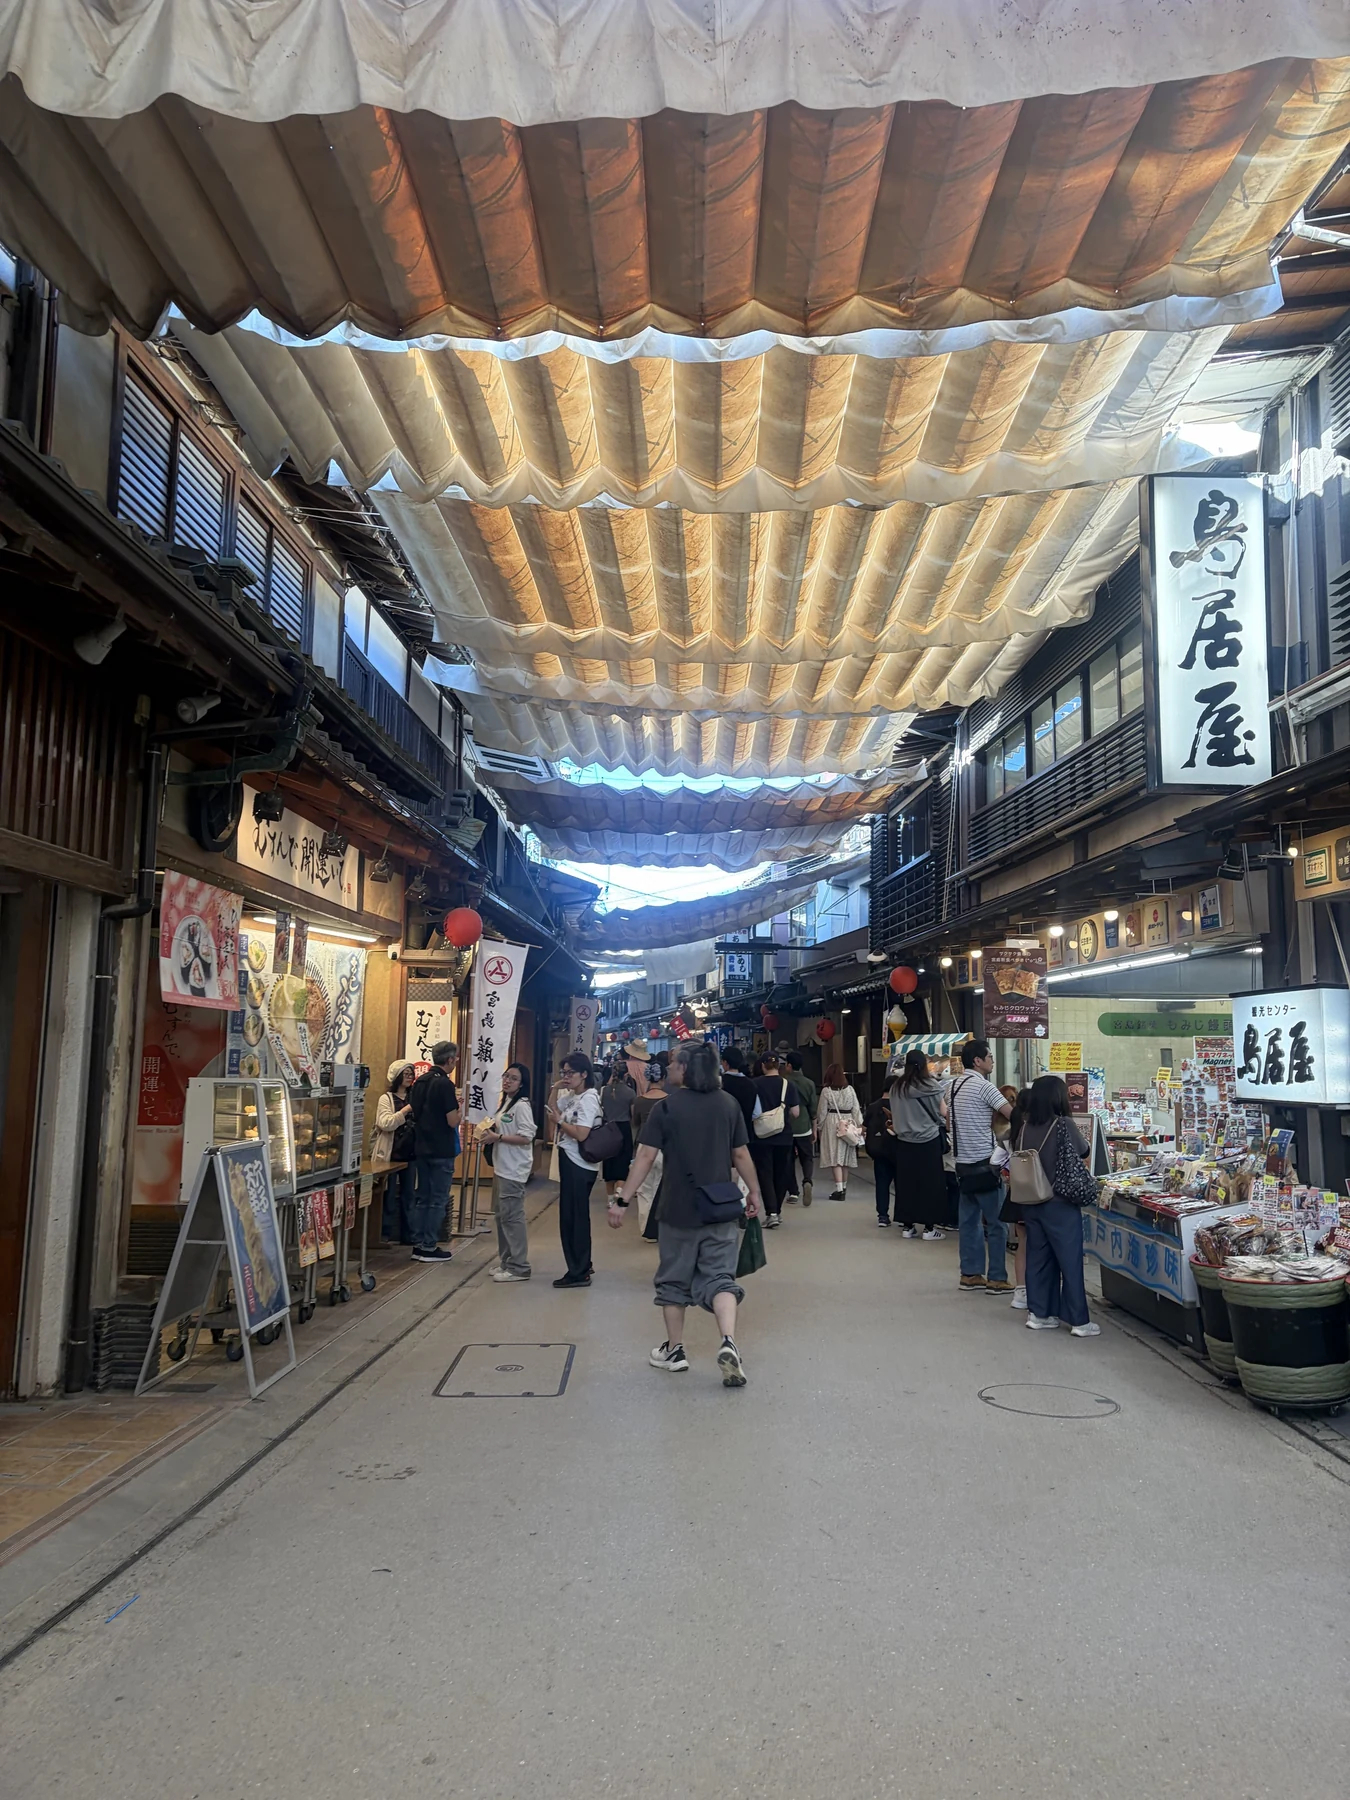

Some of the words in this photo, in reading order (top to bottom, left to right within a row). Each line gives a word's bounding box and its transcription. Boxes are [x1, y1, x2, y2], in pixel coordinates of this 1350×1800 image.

[1169, 489, 1256, 770] 鳥居屋
[1251, 1004, 1297, 1017] 観光センター
[1202, 1058, 1233, 1066] Magnet
[1237, 1020, 1315, 1086] 鳥居屋
[142, 1056, 160, 1121] 開運いて。
